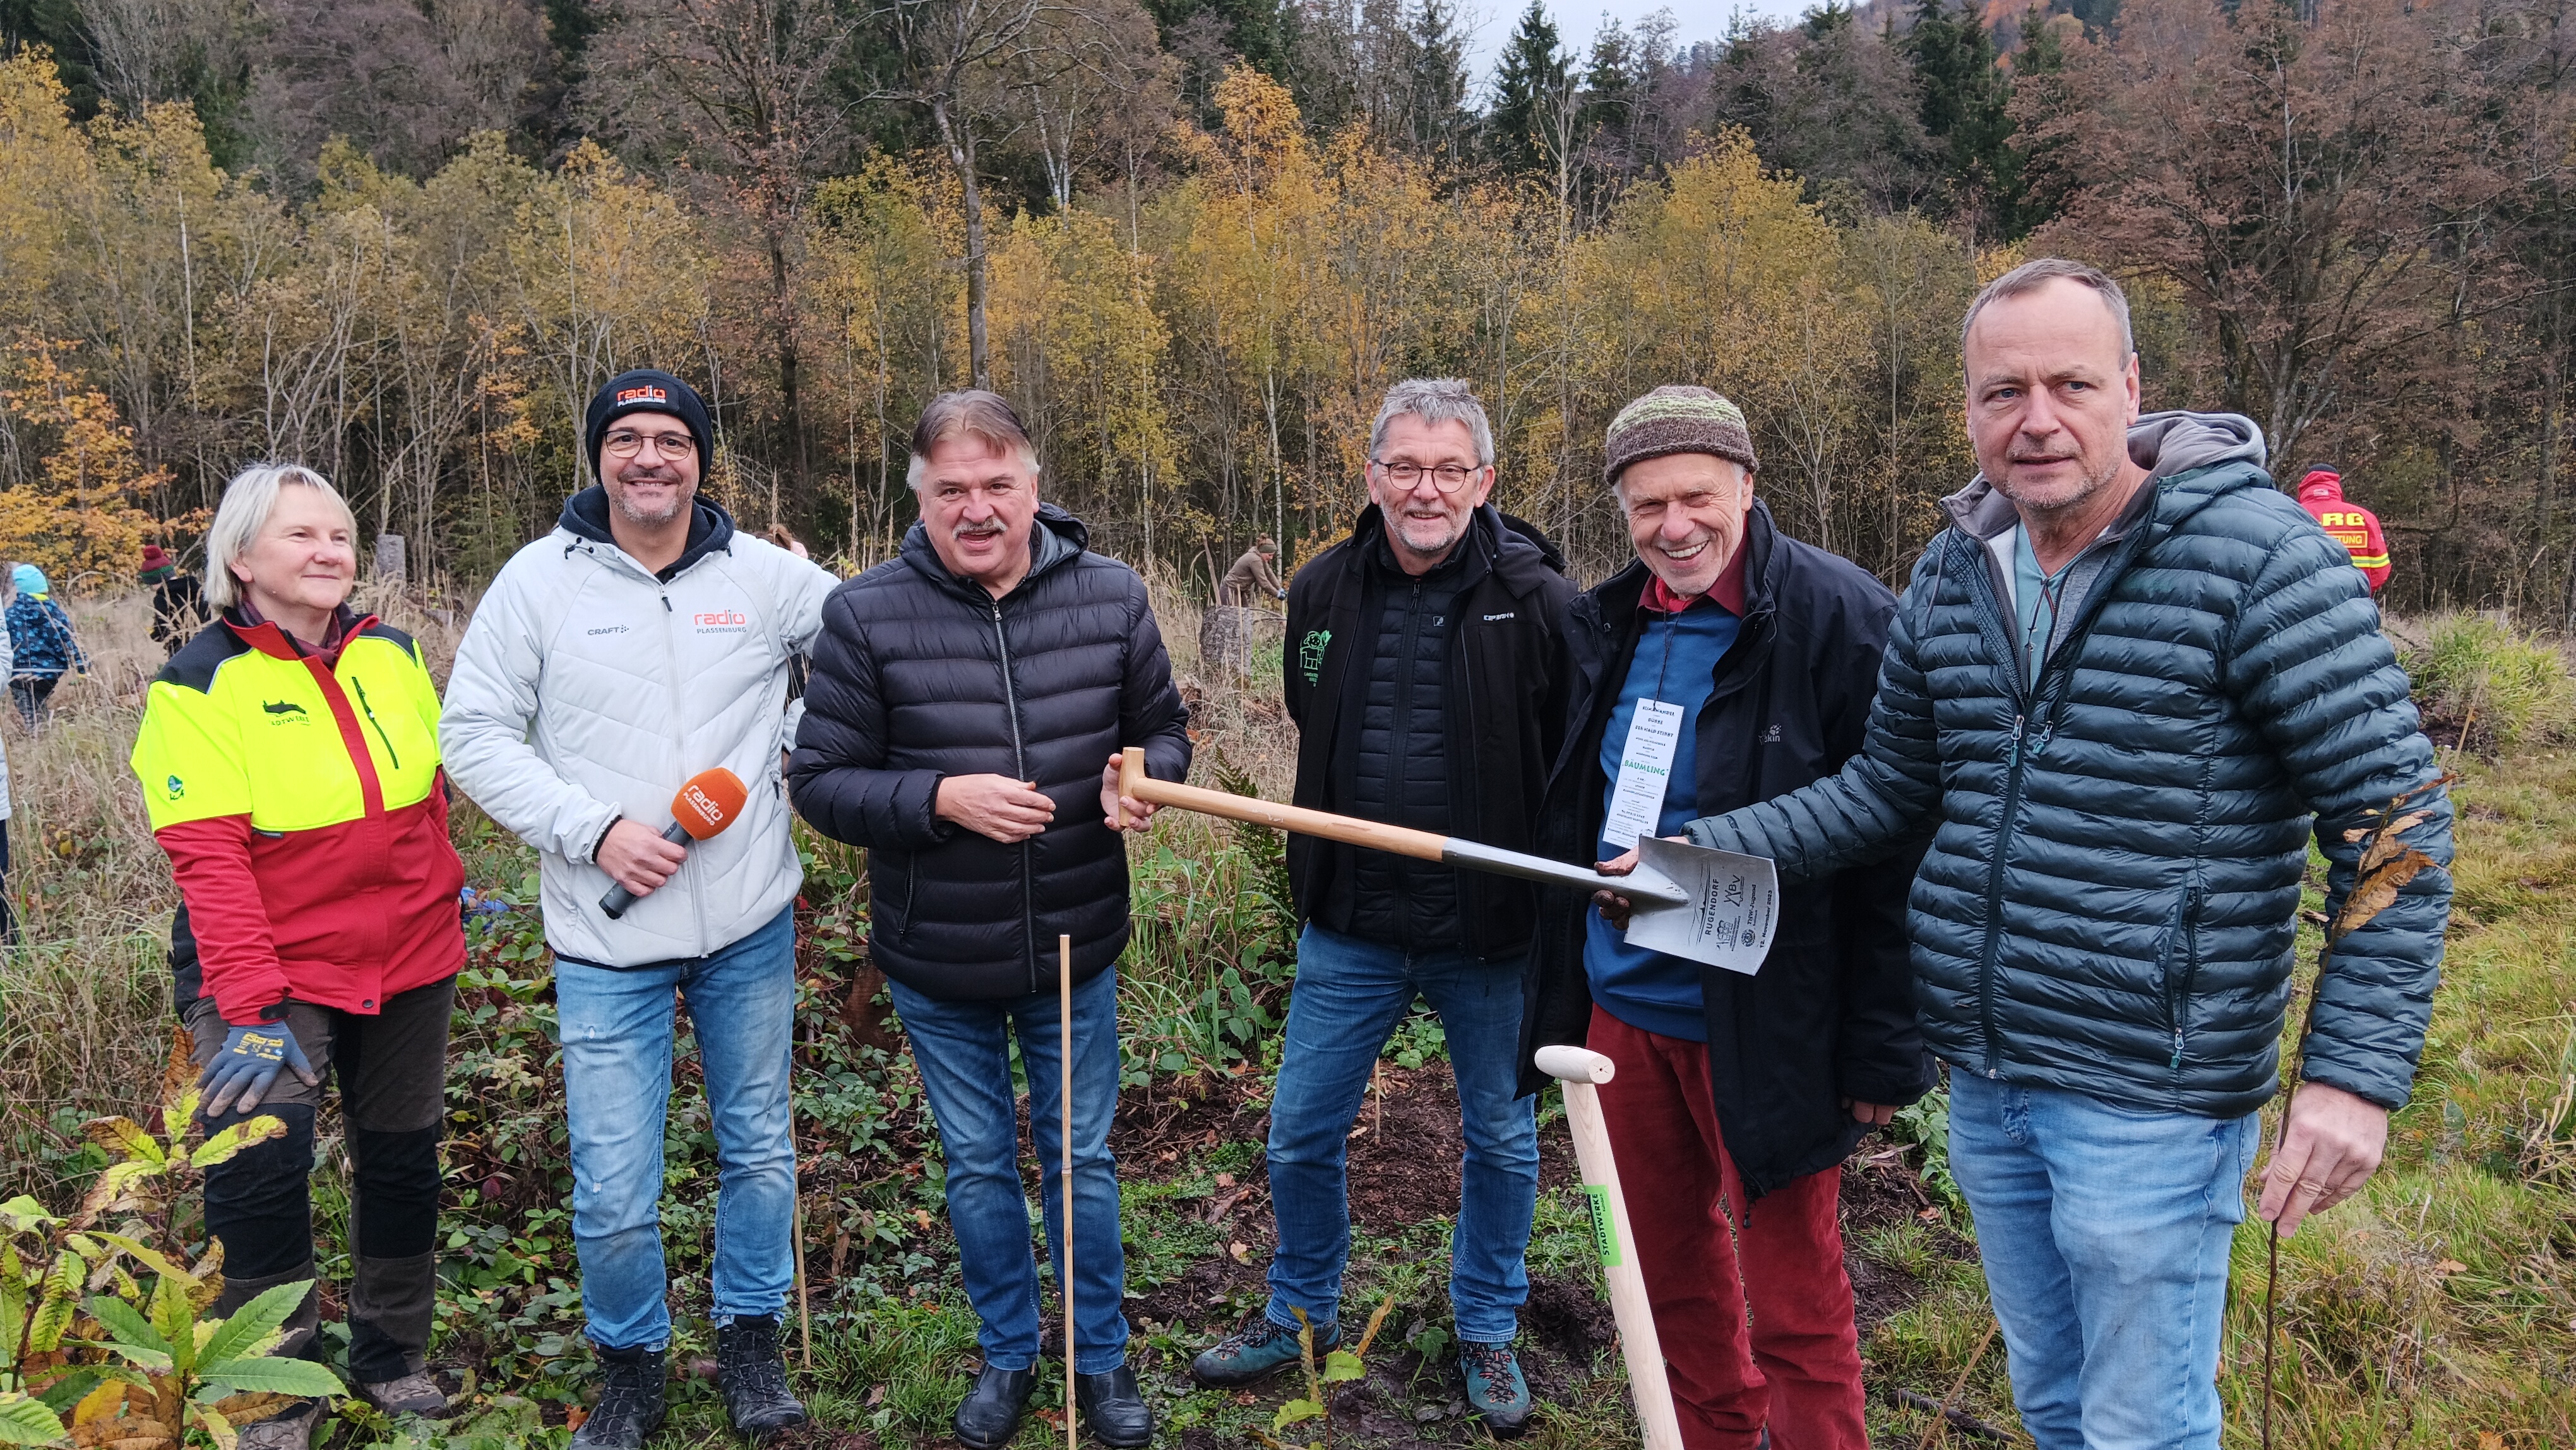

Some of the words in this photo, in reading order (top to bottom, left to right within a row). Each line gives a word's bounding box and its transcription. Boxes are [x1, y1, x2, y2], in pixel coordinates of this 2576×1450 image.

[617, 384, 666, 402] radio
[694, 609, 746, 626] radio
[587, 626, 619, 636] CRAFT
[696, 626, 747, 635] PLASSENBURG
[688, 784, 724, 821] radio
[1705, 878, 1719, 935] RUGENDORF
[1592, 1193, 1610, 1256] STADTWERKE
